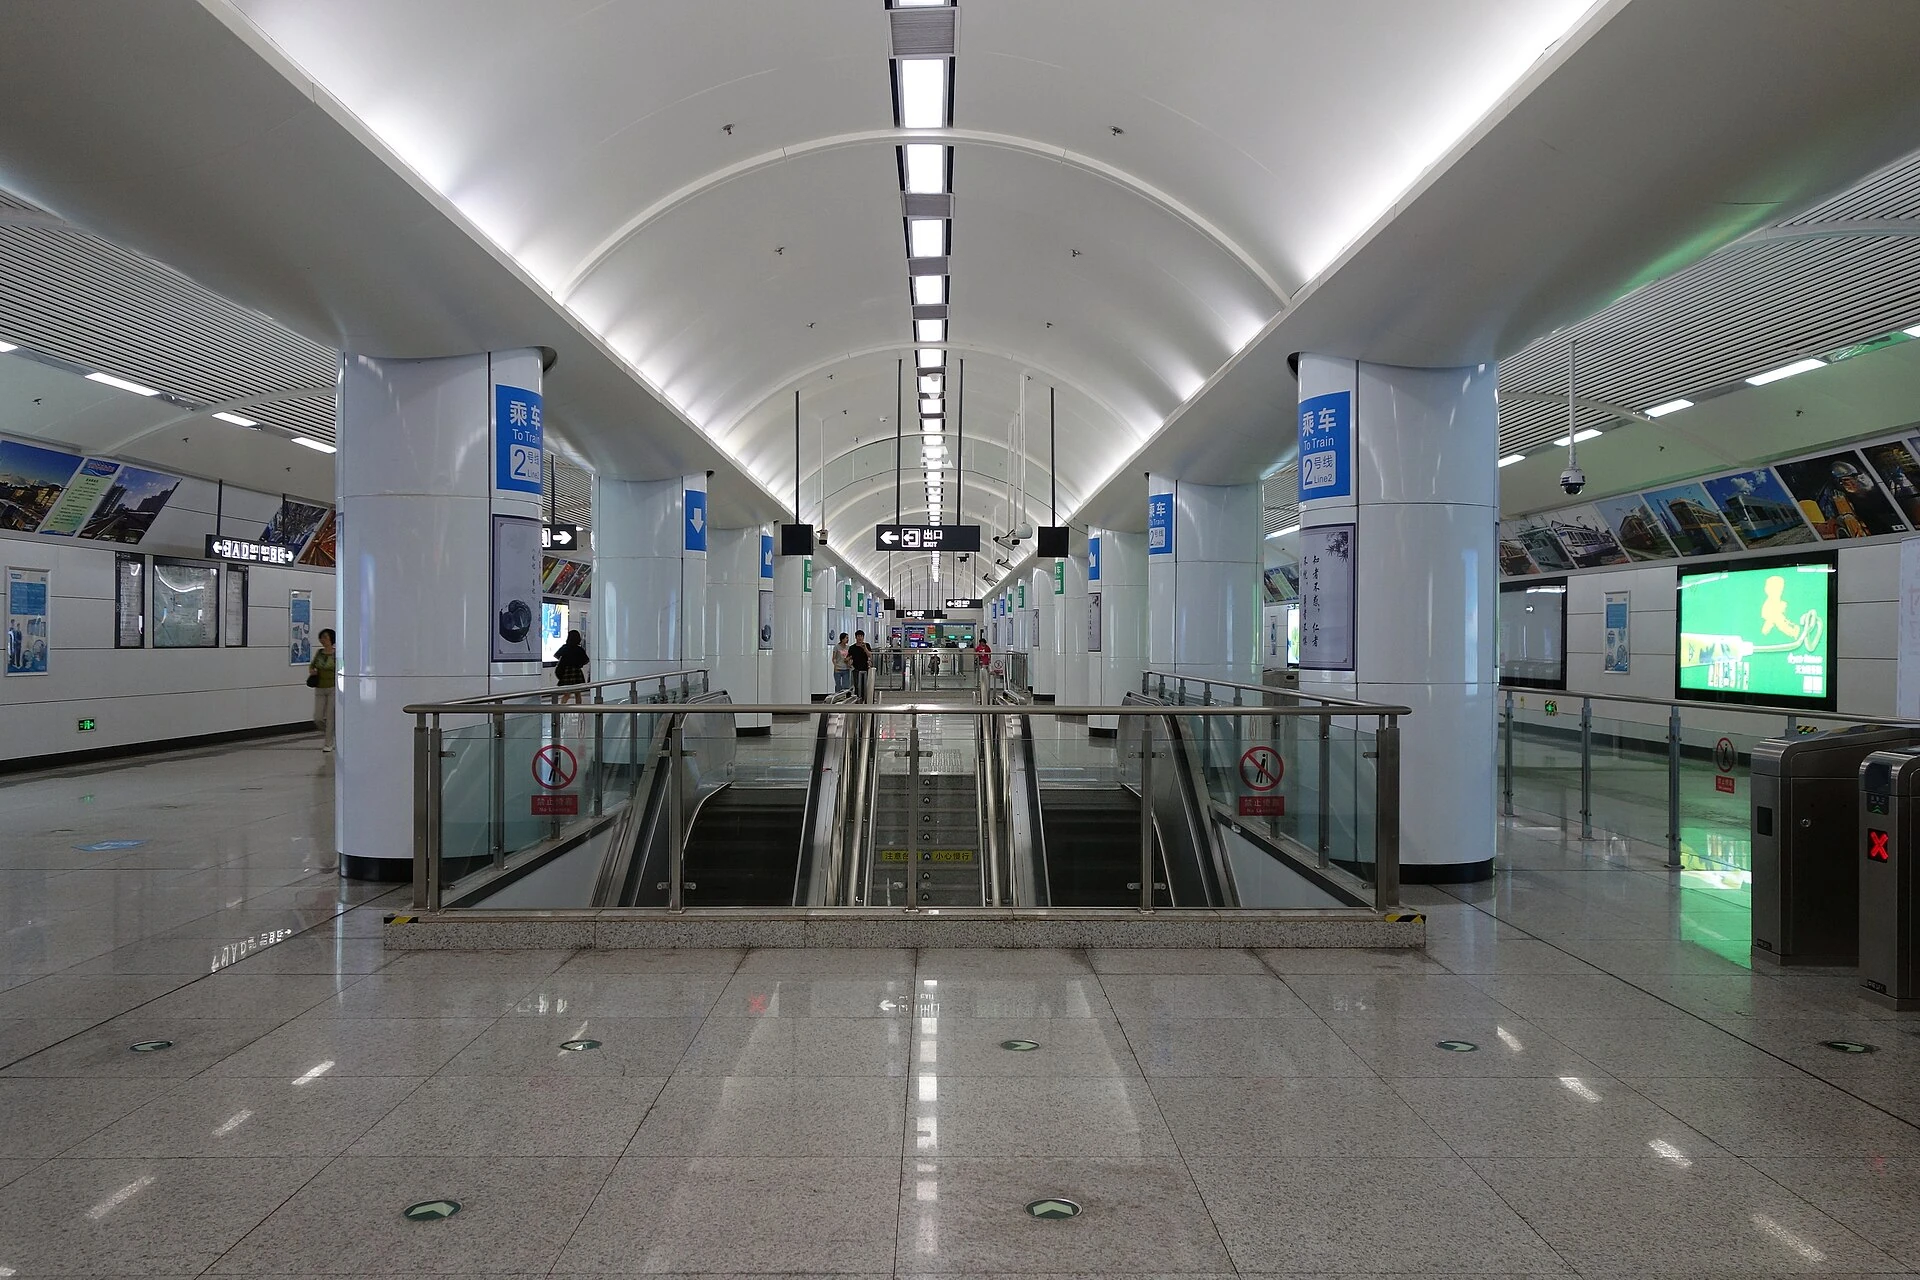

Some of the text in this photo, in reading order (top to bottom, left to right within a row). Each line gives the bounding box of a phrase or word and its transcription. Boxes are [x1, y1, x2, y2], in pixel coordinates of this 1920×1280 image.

[510, 400, 540, 430] 乘车
[1302, 407, 1337, 437] 乘车
[512, 428, 524, 440] To
[1304, 436, 1334, 451] To Train
[1313, 473, 1333, 484] Line2
[923, 529, 943, 540] 出口
